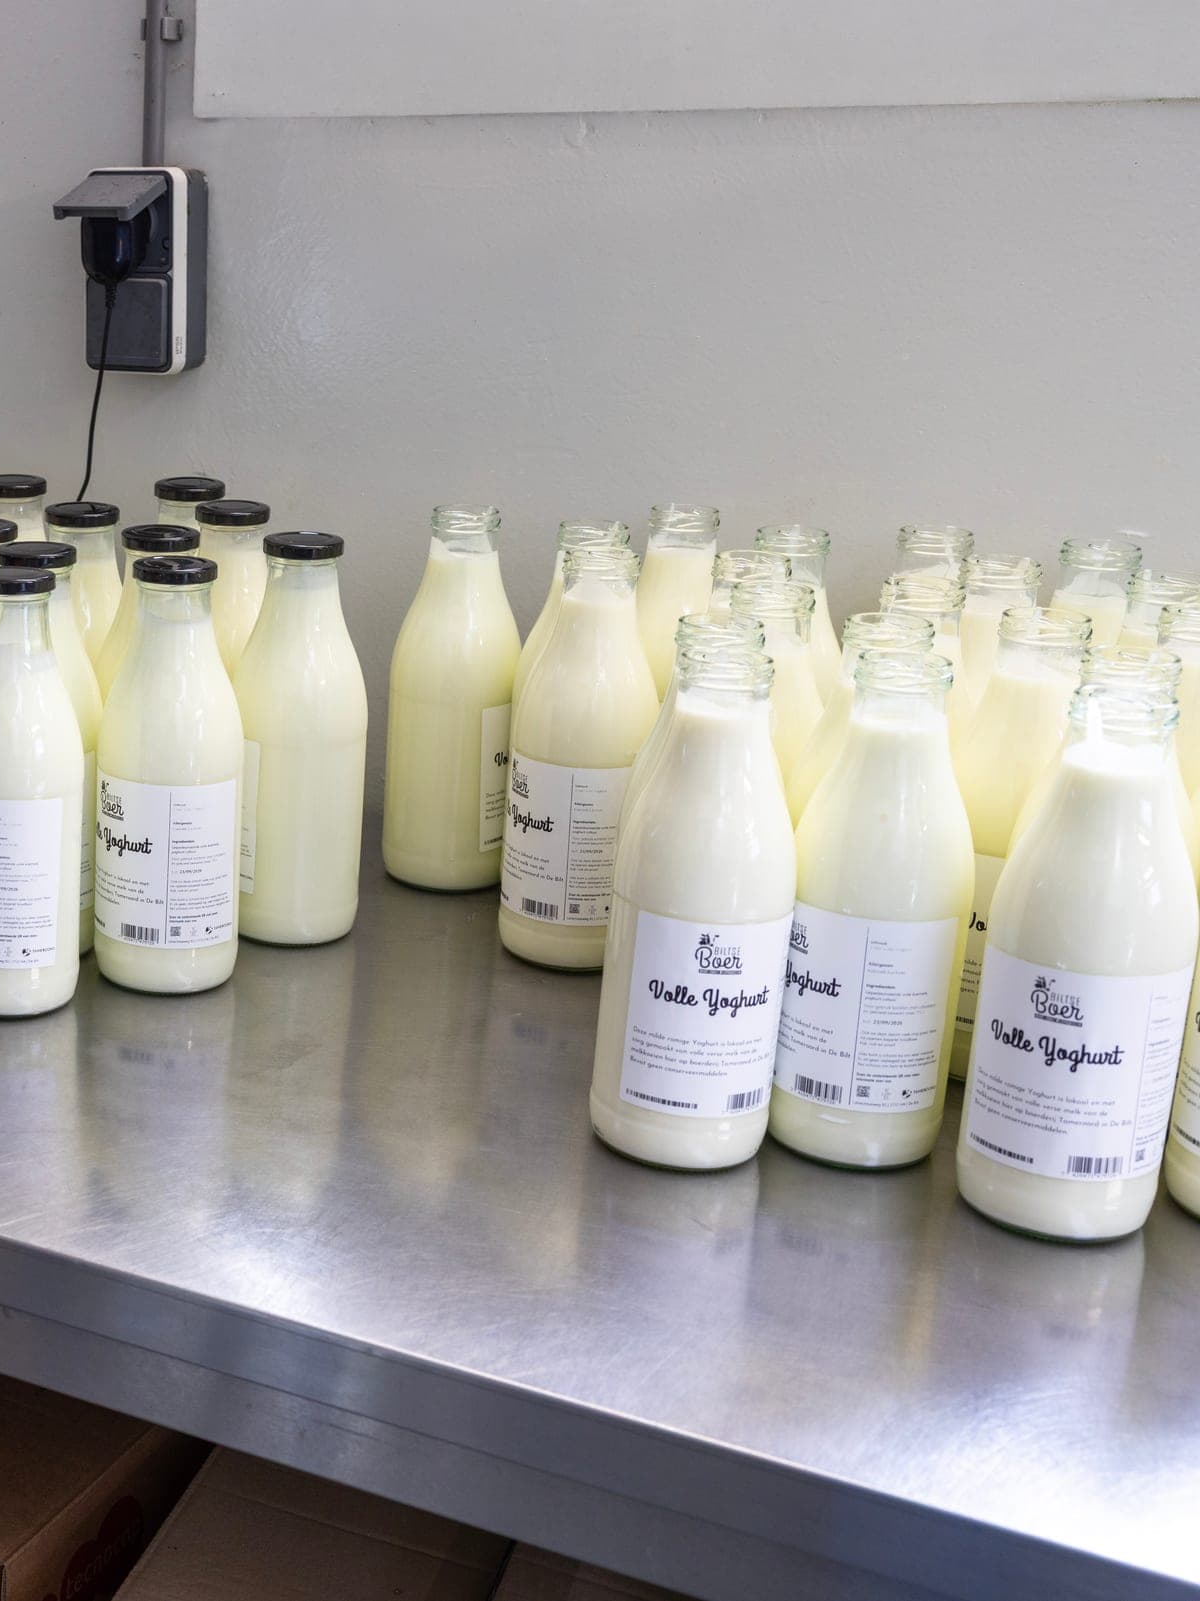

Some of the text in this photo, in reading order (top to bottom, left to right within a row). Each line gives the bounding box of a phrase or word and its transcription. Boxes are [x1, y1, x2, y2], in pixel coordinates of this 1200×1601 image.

[512, 804, 554, 834] Yoghurt
[104, 827, 153, 857] Yoghurt
[714, 947, 741, 956] BILTSE
[790, 930, 809, 949] oer
[695, 946, 743, 969] Boer
[785, 959, 842, 997] Yoghurt
[649, 979, 770, 1018] Volle Yoghurt
[1031, 989, 1084, 1021] Boer
[692, 1039, 719, 1048] Yoghurt
[991, 1019, 1125, 1073] Volle Yoghurt
[1027, 1088, 1056, 1101] Yoghurt
